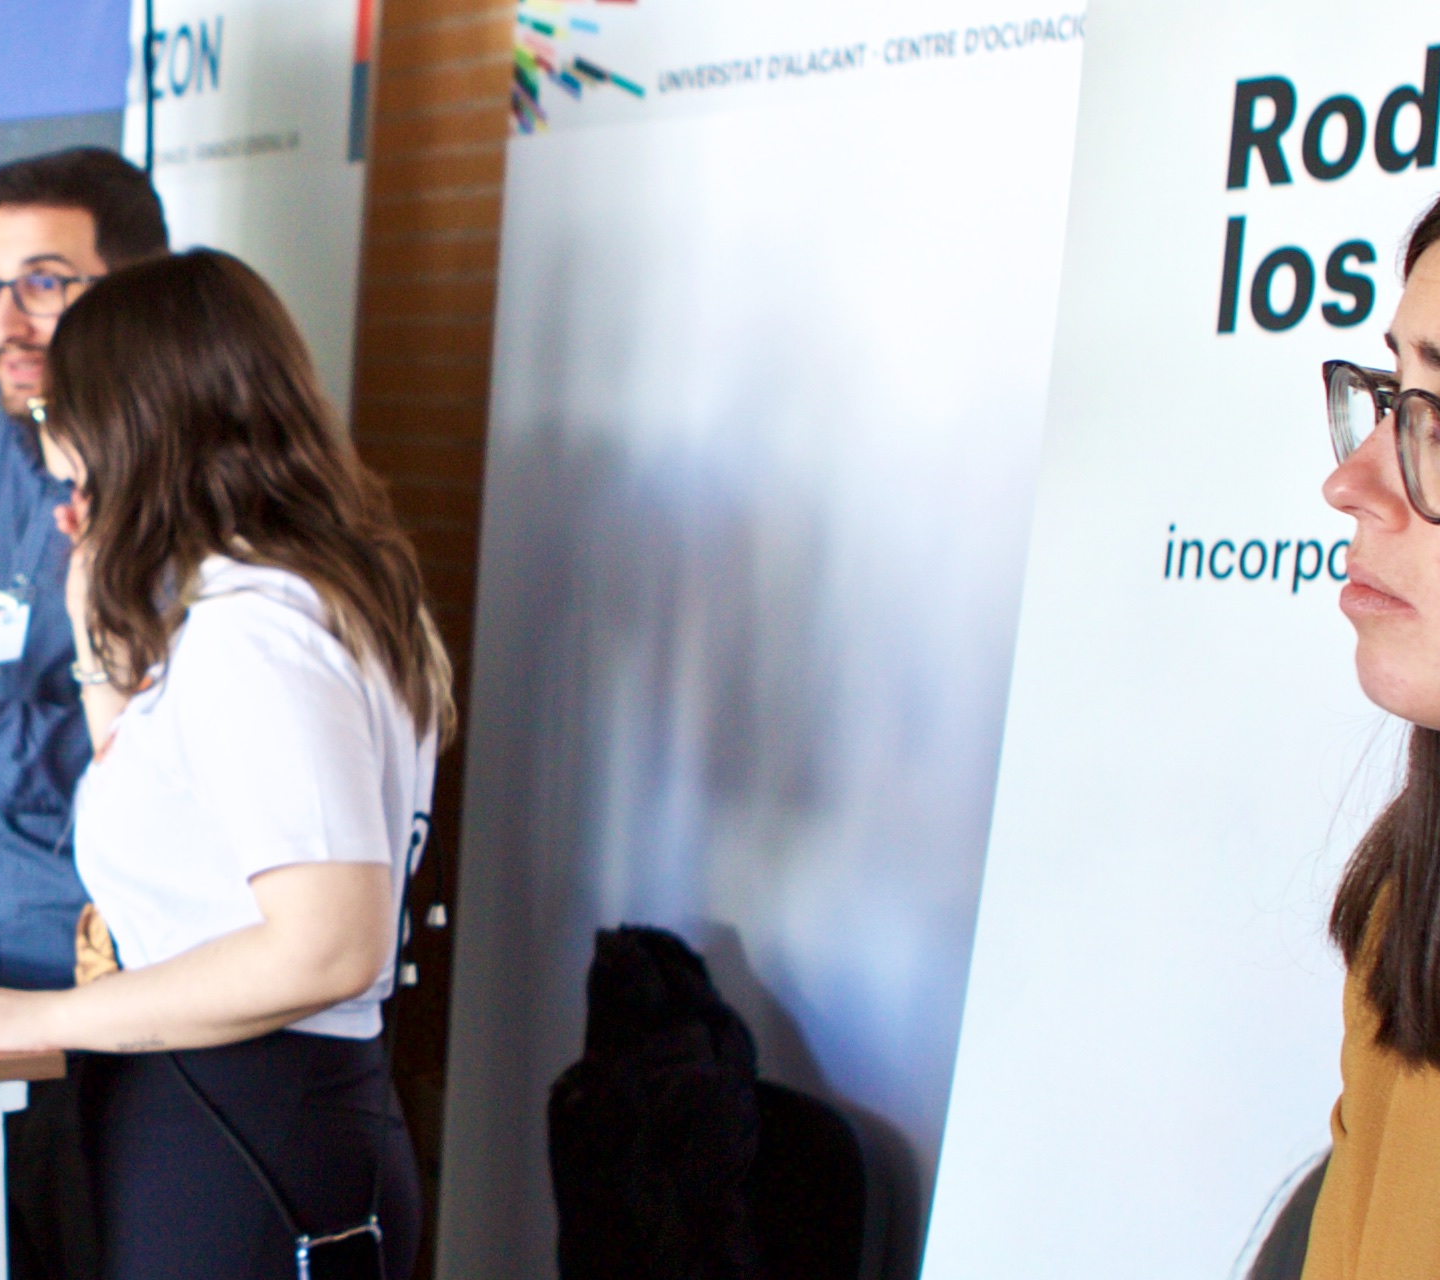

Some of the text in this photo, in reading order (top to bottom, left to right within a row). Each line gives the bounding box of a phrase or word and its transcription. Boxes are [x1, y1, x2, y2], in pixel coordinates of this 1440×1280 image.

[134, 17, 224, 102] ZON
[657, 56, 762, 93] UNIVERSITAT
[767, 42, 867, 80] D'ALACANT
[883, 30, 958, 65] CENTRE
[1216, 215, 1378, 335] los
